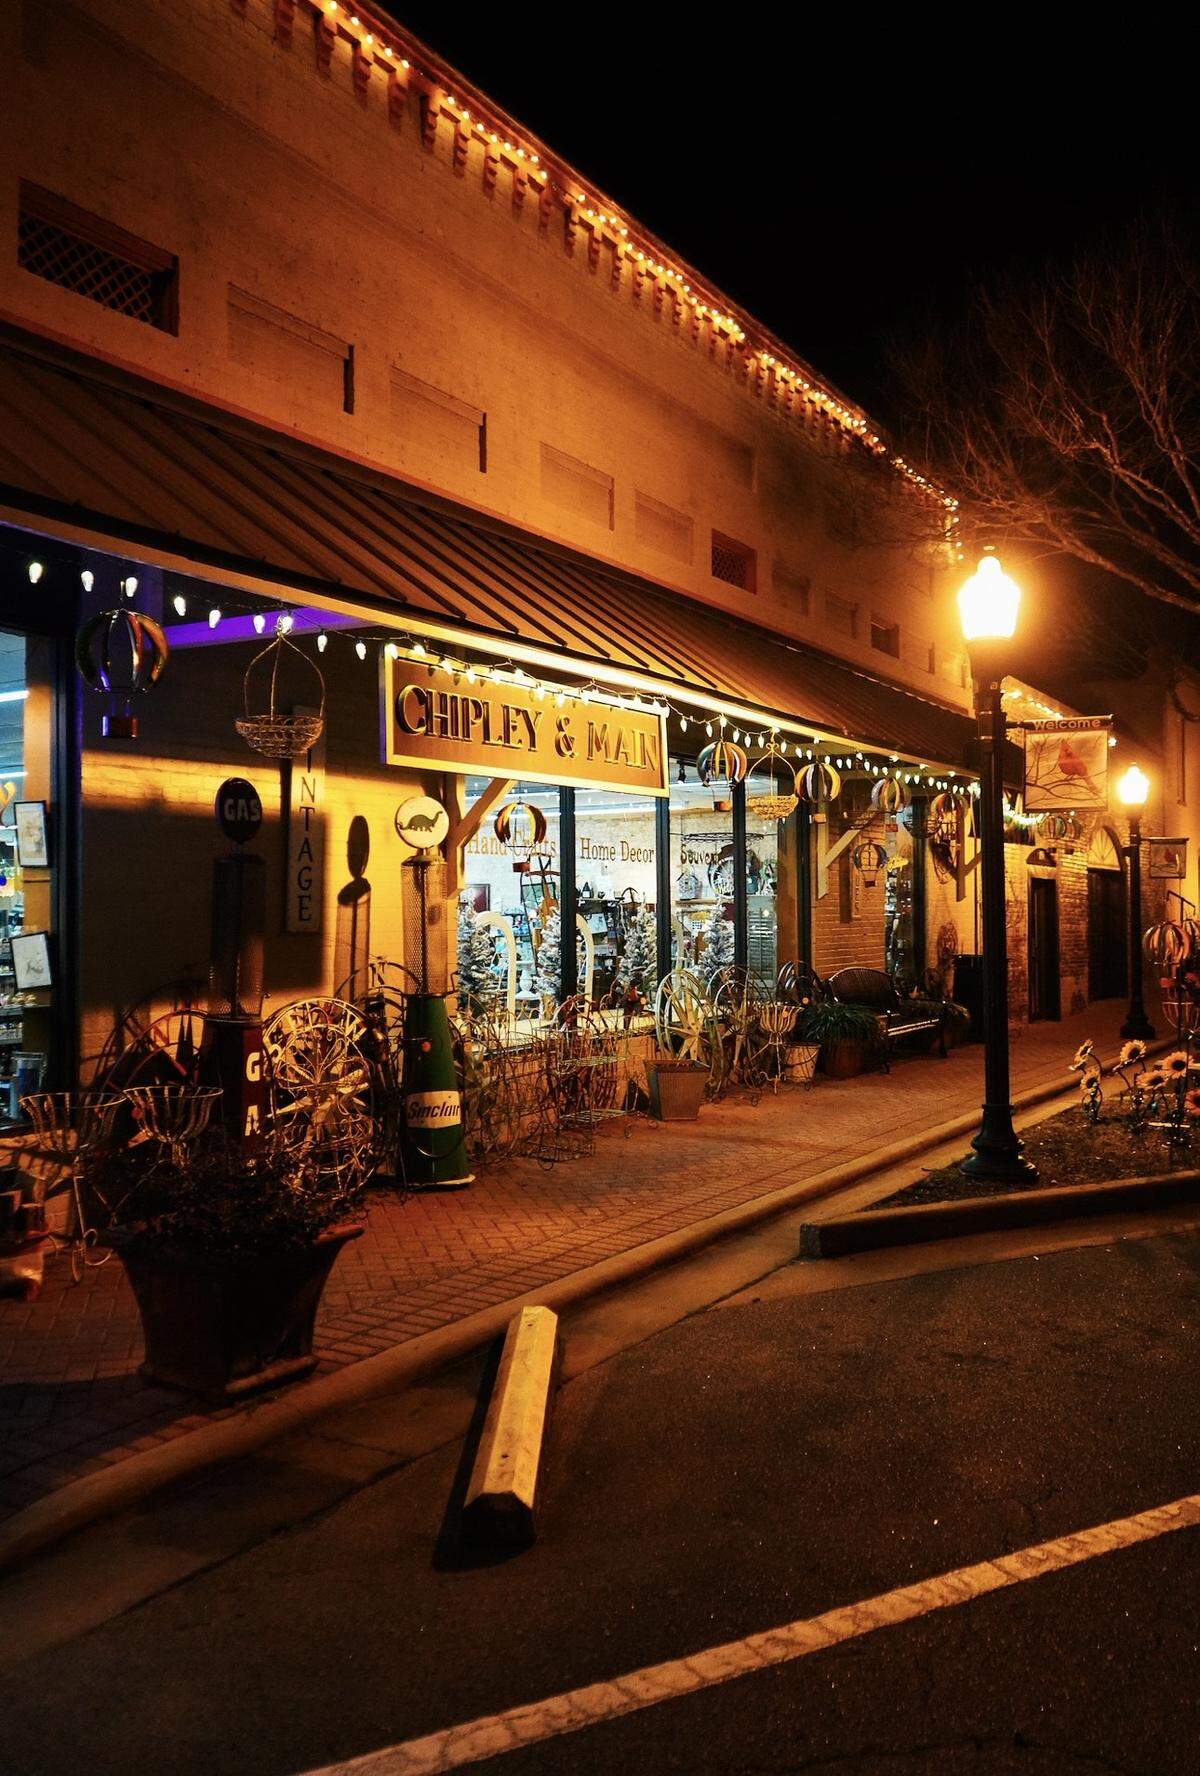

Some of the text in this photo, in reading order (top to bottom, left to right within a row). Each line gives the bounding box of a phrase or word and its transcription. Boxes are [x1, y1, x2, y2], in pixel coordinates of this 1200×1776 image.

[397, 684, 658, 771] CHIPLEY & MAIN
[223, 799, 261, 822] GAS
[297, 748, 316, 922] INTAGE
[580, 837, 655, 863] Home Decor
[245, 1052, 263, 1137] GA
[407, 1101, 460, 1119] Sinclair
